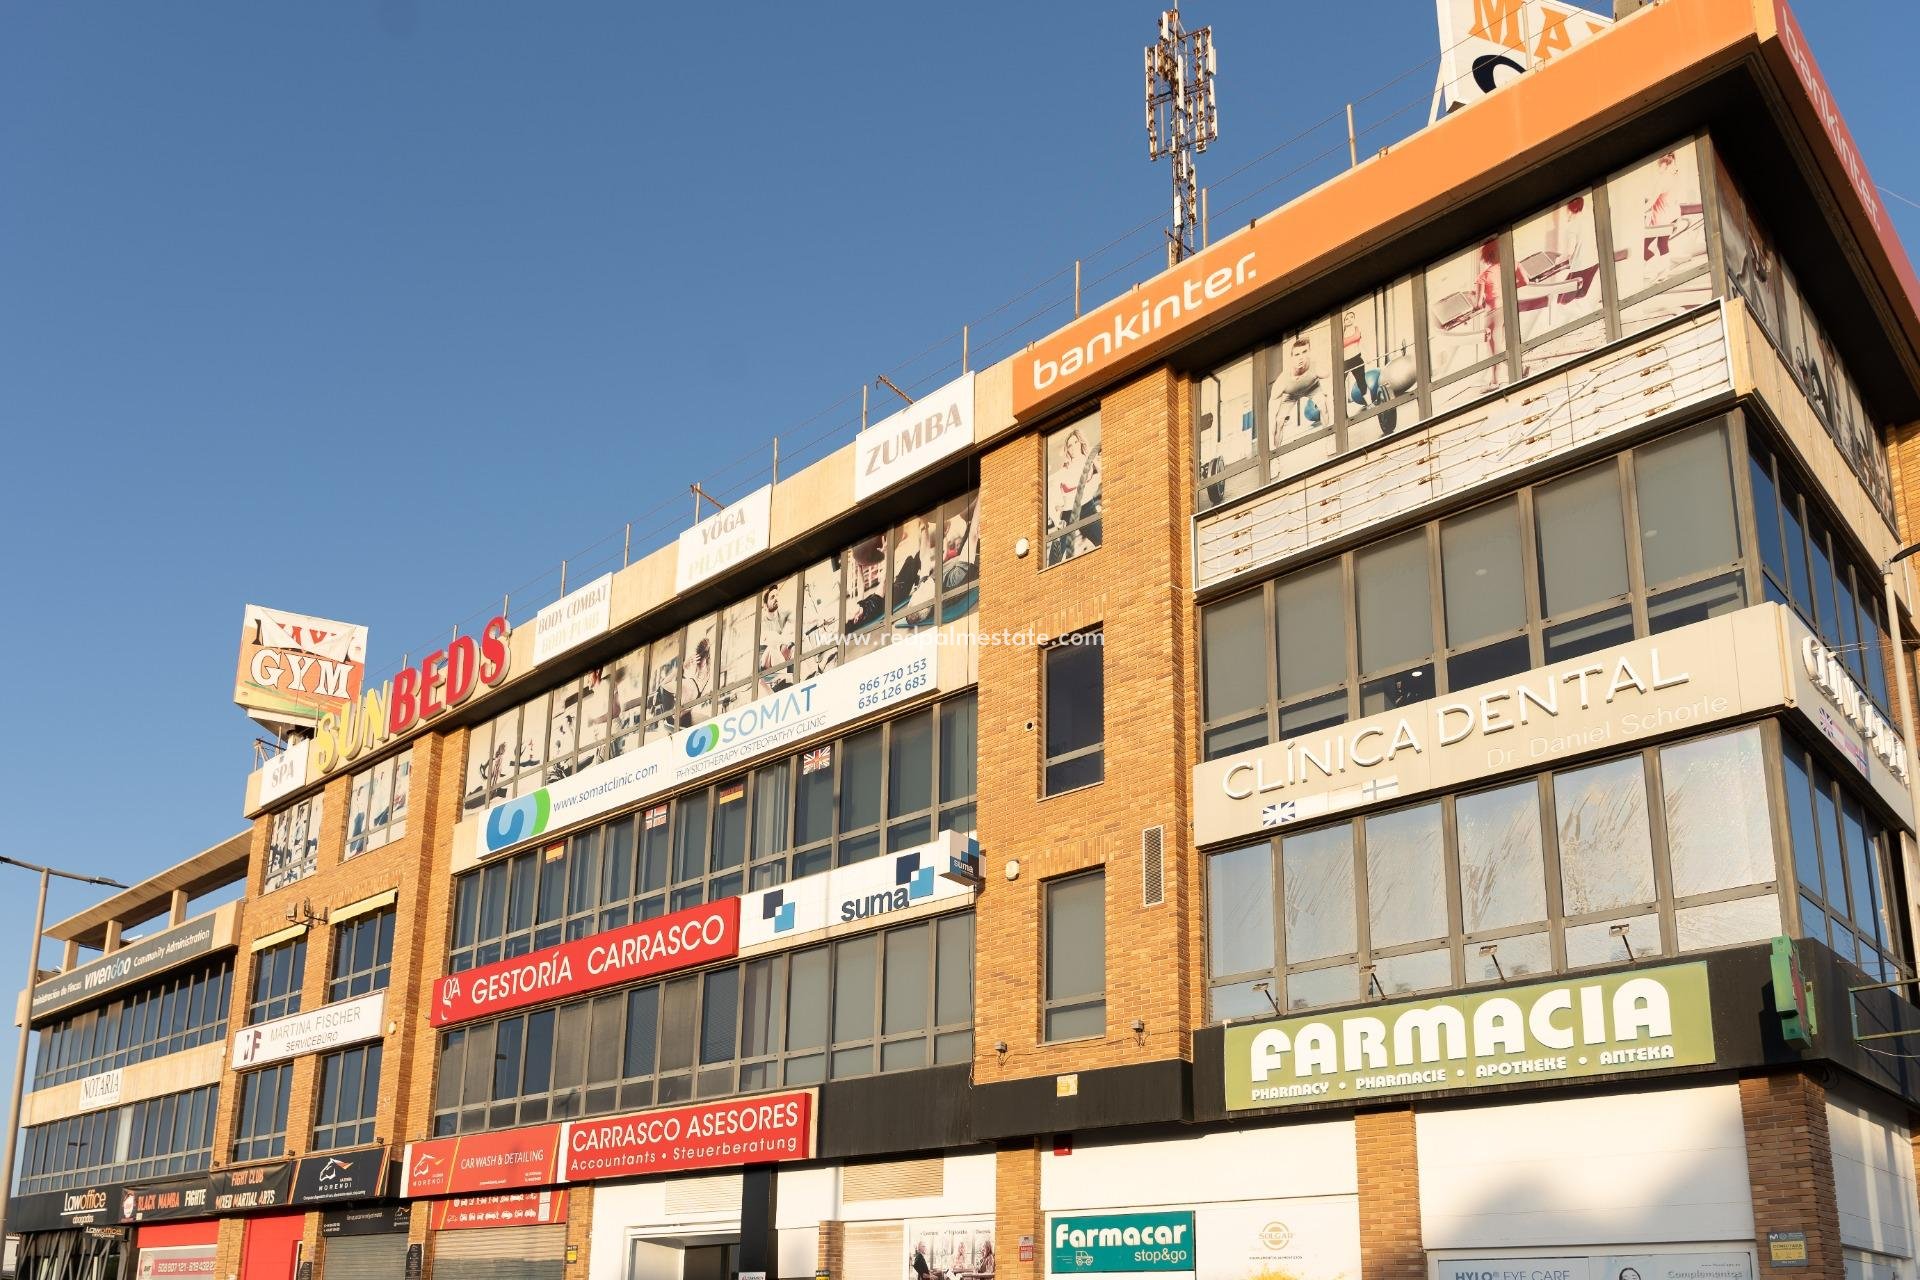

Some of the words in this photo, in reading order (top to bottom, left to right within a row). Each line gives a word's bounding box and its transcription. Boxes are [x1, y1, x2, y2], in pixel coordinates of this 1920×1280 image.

[865, 402, 962, 477] ZUMBA
[701, 507, 746, 545] YOGA
[687, 531, 757, 581] PILATES
[538, 606, 564, 634] BODY
[566, 583, 609, 619] COMBAT
[541, 625, 567, 654] BODY
[251, 648, 355, 700] GYM
[857, 693, 880, 710] 636
[882, 685, 903, 702] 126
[905, 675, 927, 691] 683
[858, 680, 881, 695] 966
[883, 669, 904, 686] 730
[906, 658, 928, 676] 153
[722, 683, 817, 743] SOMAT
[1222, 718, 1422, 801] CLÍNICA
[1437, 647, 1690, 747] DENTAL
[675, 747, 739, 780] PHYSIOTHERAPY
[740, 728, 795, 758] OSTEOPATHY
[796, 714, 827, 737] CLINIC
[1487, 749, 1521, 769] Dr.
[1529, 721, 1611, 758] Daniel
[271, 760, 295, 788] SPA
[553, 762, 658, 812] www.somatclinic.com
[953, 859, 974, 874] suma
[840, 887, 910, 922] suma
[133, 946, 165, 968] Community
[165, 929, 210, 954] Administration
[471, 951, 573, 1004] GESTORÍA
[587, 914, 725, 975] CARRASCO
[270, 1022, 311, 1042] MARTINA
[315, 1006, 361, 1031] FISCHER
[286, 1031, 338, 1052] SERVICEBÜRO
[1250, 976, 1673, 1082] FARMACIA
[1251, 1081, 1329, 1100] PHARMACY
[1355, 1069, 1446, 1090] PHARMACIE
[1475, 1056, 1567, 1078] APOTHEKE
[572, 1118, 682, 1152] CARRASCO
[686, 1101, 799, 1139] ASESORES
[460, 1158, 474, 1169] CAR
[475, 1154, 497, 1167] WASH
[504, 1149, 544, 1164] DETAILING
[570, 1152, 656, 1172] Accountants
[672, 1136, 797, 1161] Steuerberatung
[231, 1170, 249, 1187] FIGHT
[249, 1168, 264, 1184] CLUB
[64, 1189, 107, 1212] Lawoffice
[138, 1195, 155, 1211] BLACK
[158, 1192, 180, 1210] MAMBA
[215, 1195, 233, 1210] MIXED
[233, 1191, 258, 1208] MARTIAL
[258, 1189, 276, 1205] ARTS
[1134, 1248, 1187, 1264] stop&go
